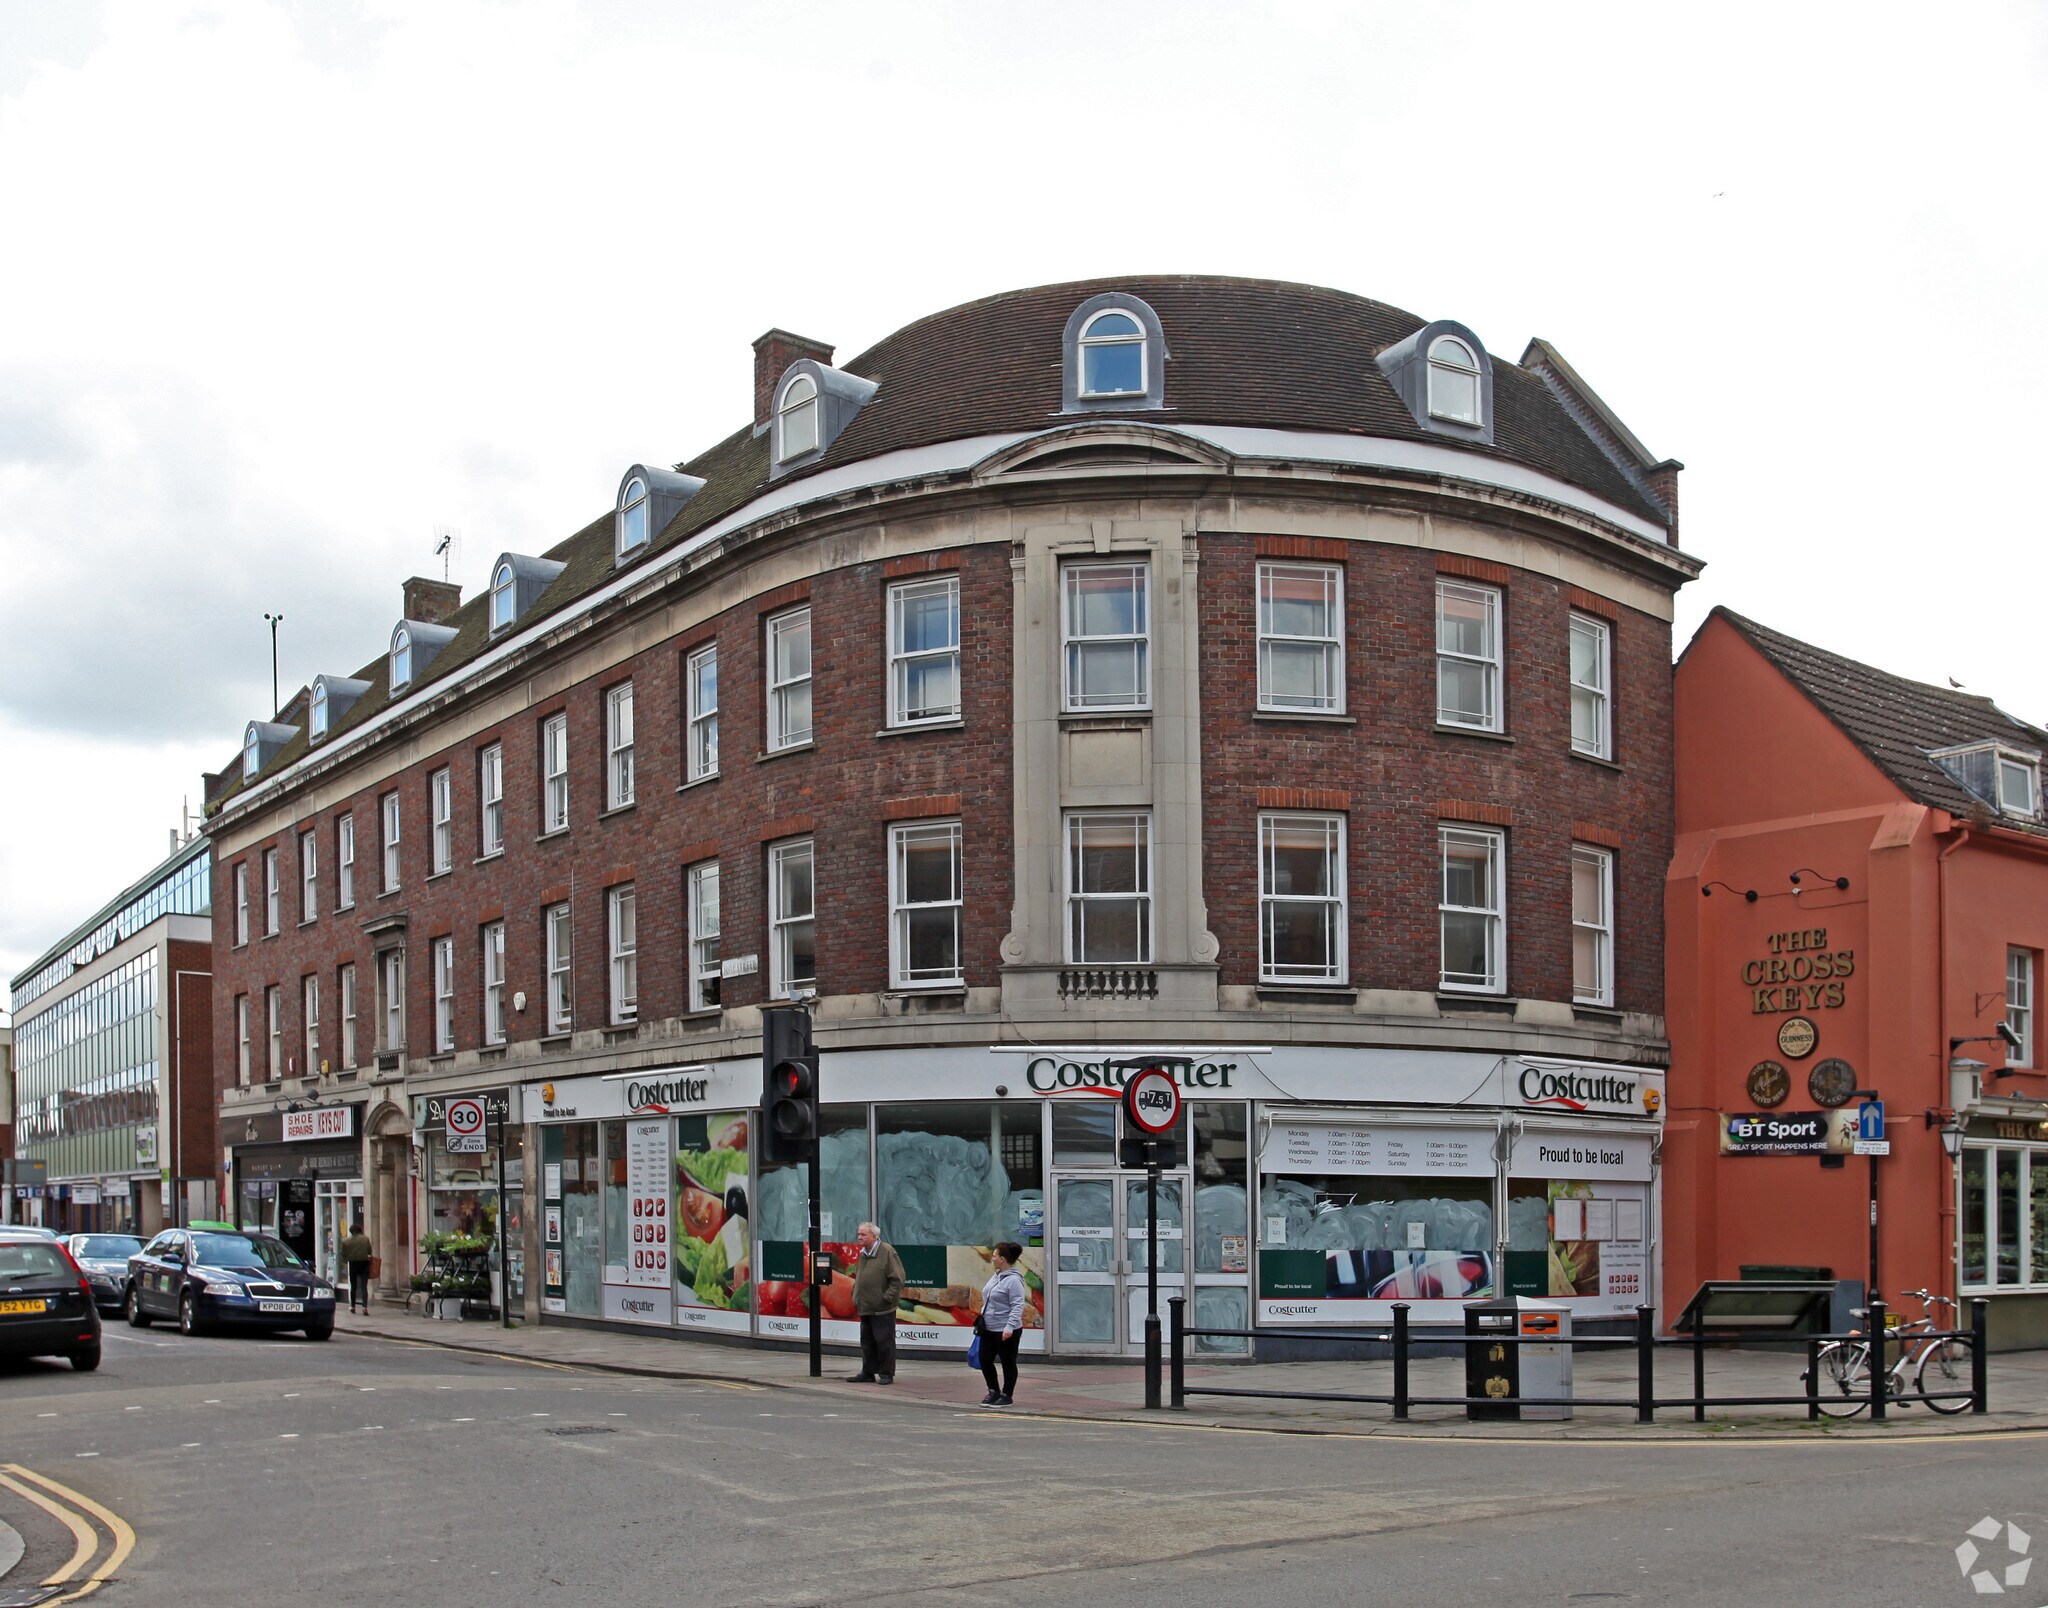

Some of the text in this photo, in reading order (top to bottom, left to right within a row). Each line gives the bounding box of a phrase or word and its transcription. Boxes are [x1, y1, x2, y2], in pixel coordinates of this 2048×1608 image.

[1767, 927, 1827, 954] THE
[1742, 949, 1855, 986] CROSS
[1751, 981, 1845, 1014] KEYS
[1780, 1034, 1813, 1044] GUINNESS
[628, 1077, 708, 1109] Costcutter
[1519, 1068, 1636, 1105] Costcutter
[288, 1112, 313, 1126] SHOE
[317, 1110, 345, 1134] KEYS CUT
[453, 1110, 478, 1124] 30
[288, 1124, 314, 1137] REPAIRS
[637, 1126, 660, 1136] Costcutter
[1738, 1120, 1817, 1140] BT Sport
[1996, 1121, 2025, 1138] THE
[1539, 1146, 1624, 1165] Proud to be local
[20, 1300, 41, 1310] YTG
[622, 1298, 655, 1313] Costcutter
[1268, 1305, 1318, 1315] Costcutter
[684, 1312, 706, 1321] Costcutter
[768, 1320, 800, 1331] Costcutter
[895, 1330, 940, 1340] Costcutter
